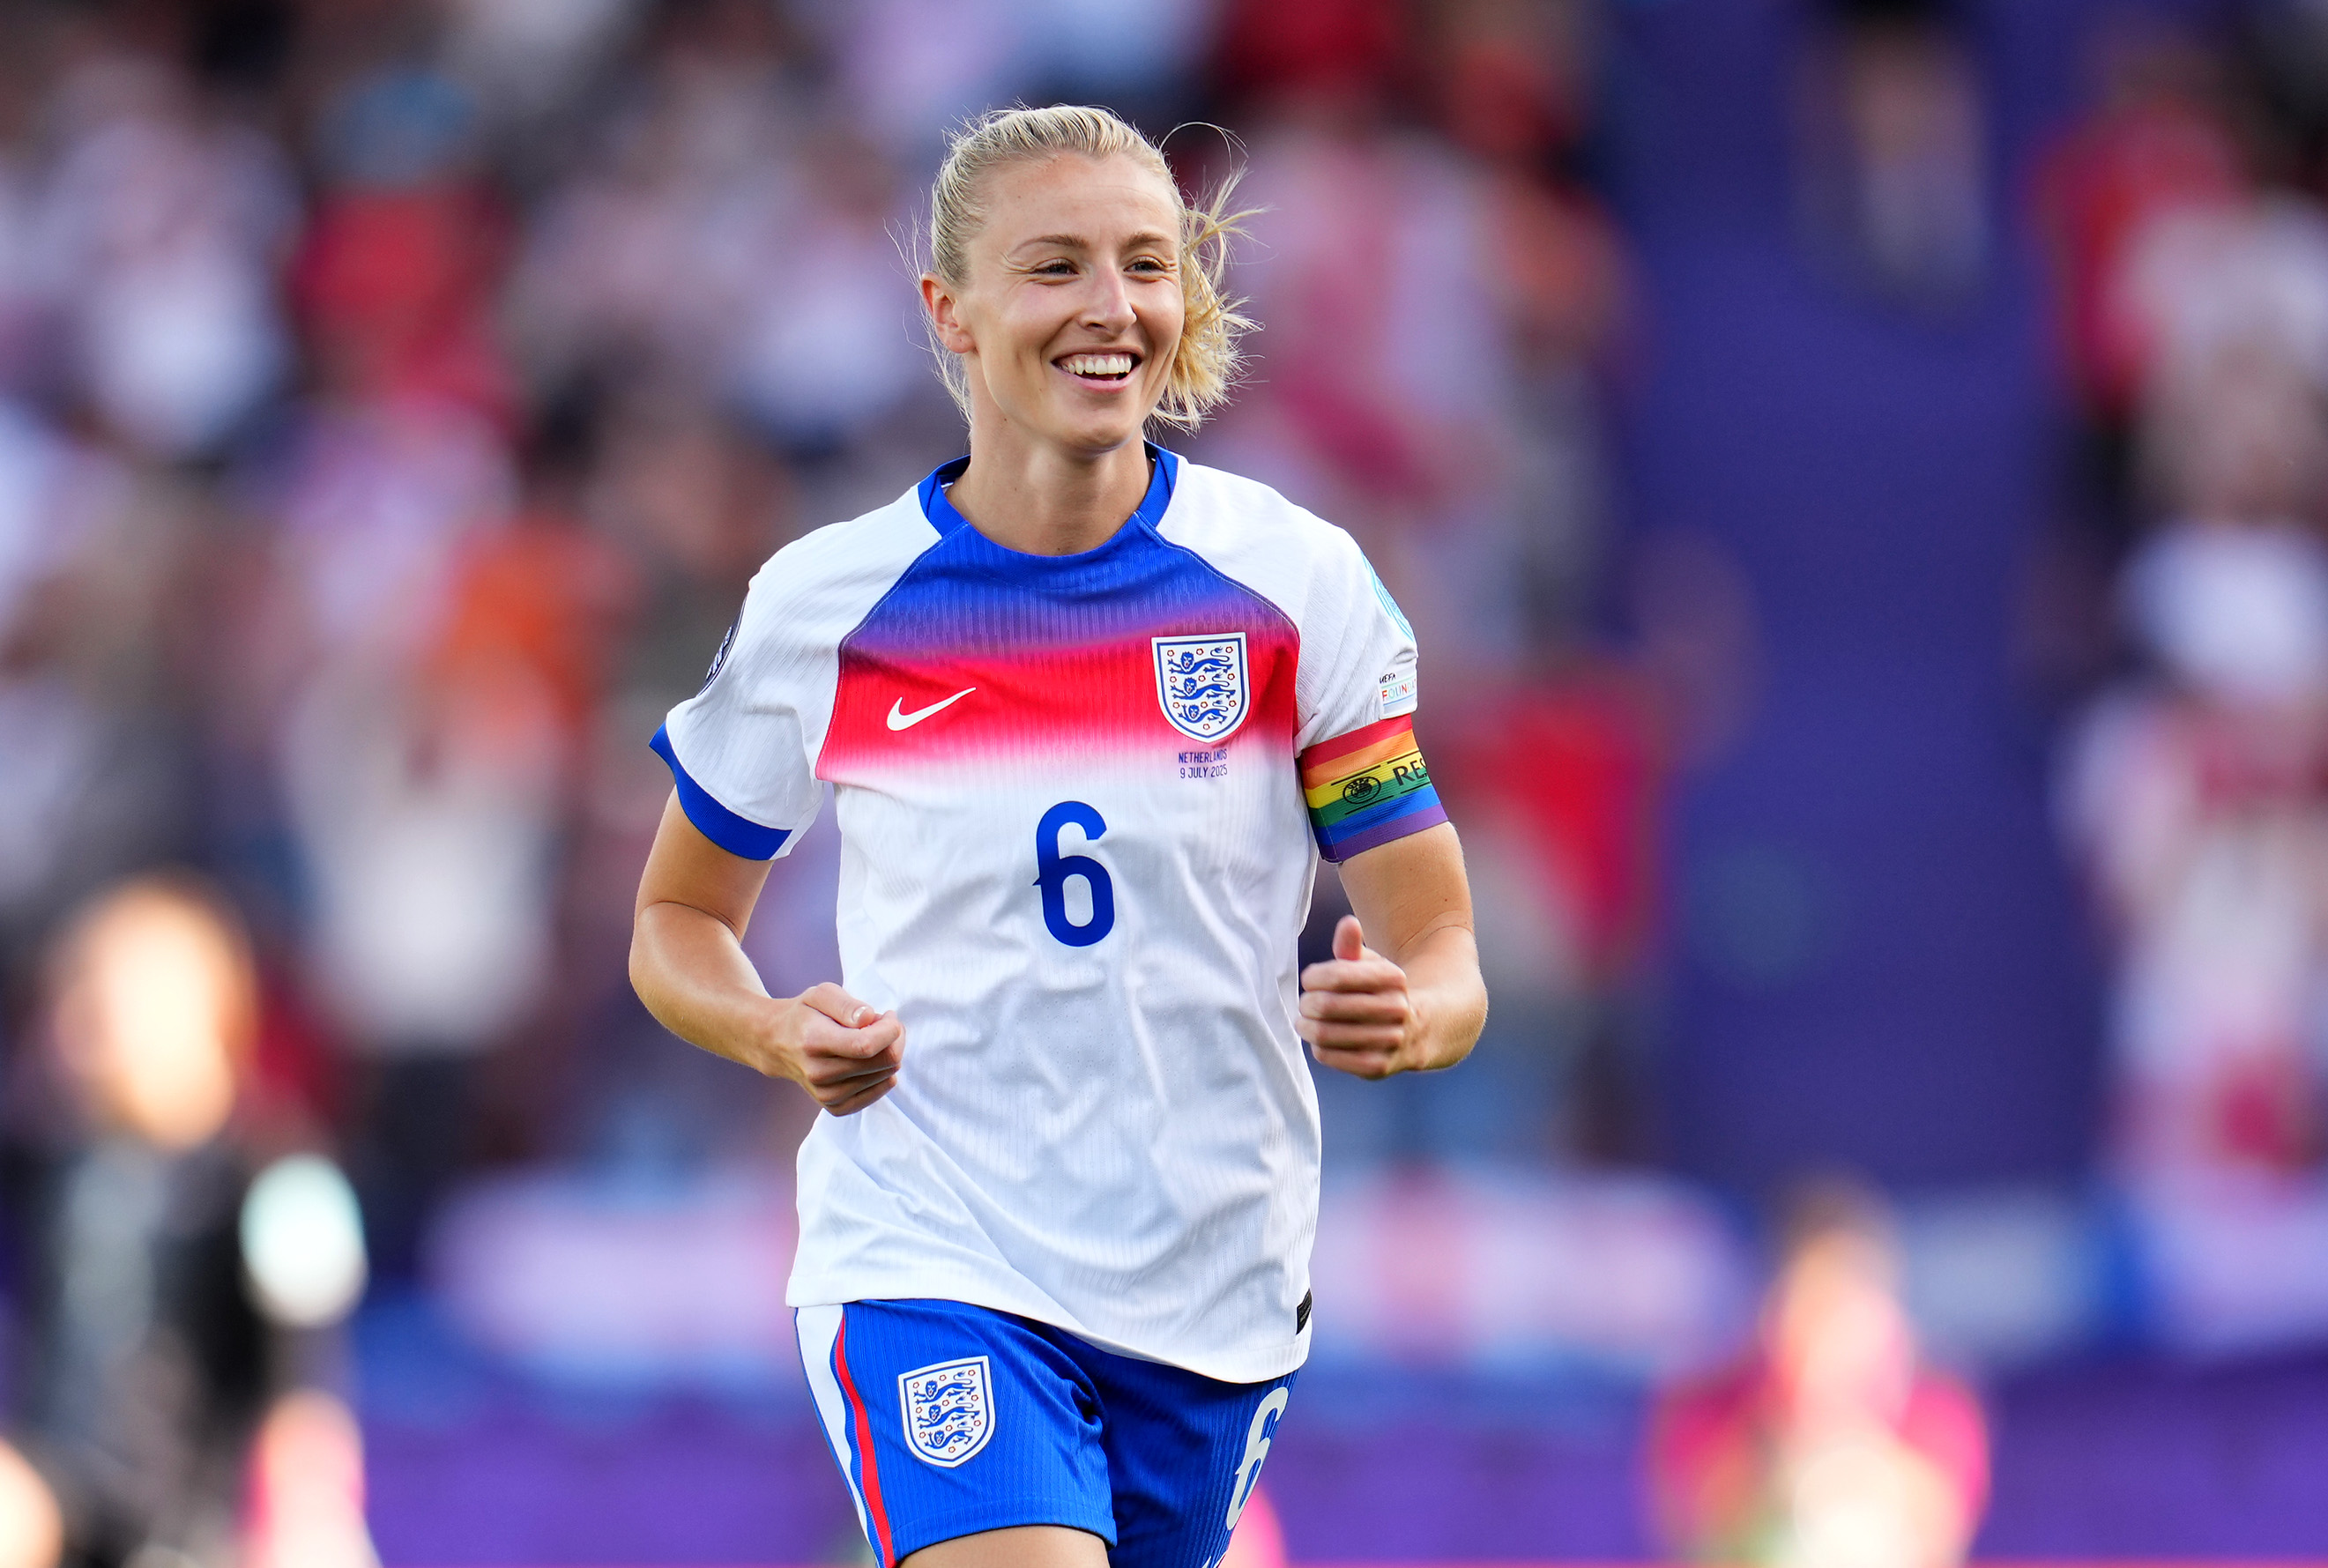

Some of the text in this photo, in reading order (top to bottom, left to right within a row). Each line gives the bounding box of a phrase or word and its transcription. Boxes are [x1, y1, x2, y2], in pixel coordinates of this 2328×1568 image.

[1379, 673, 1396, 684] UEFA
[1178, 748, 1228, 763] NETHERLANDS
[1179, 763, 1228, 779] 9 JULY 2025
[1032, 800, 1115, 947] 6
[1226, 1386, 1289, 1530] 6
